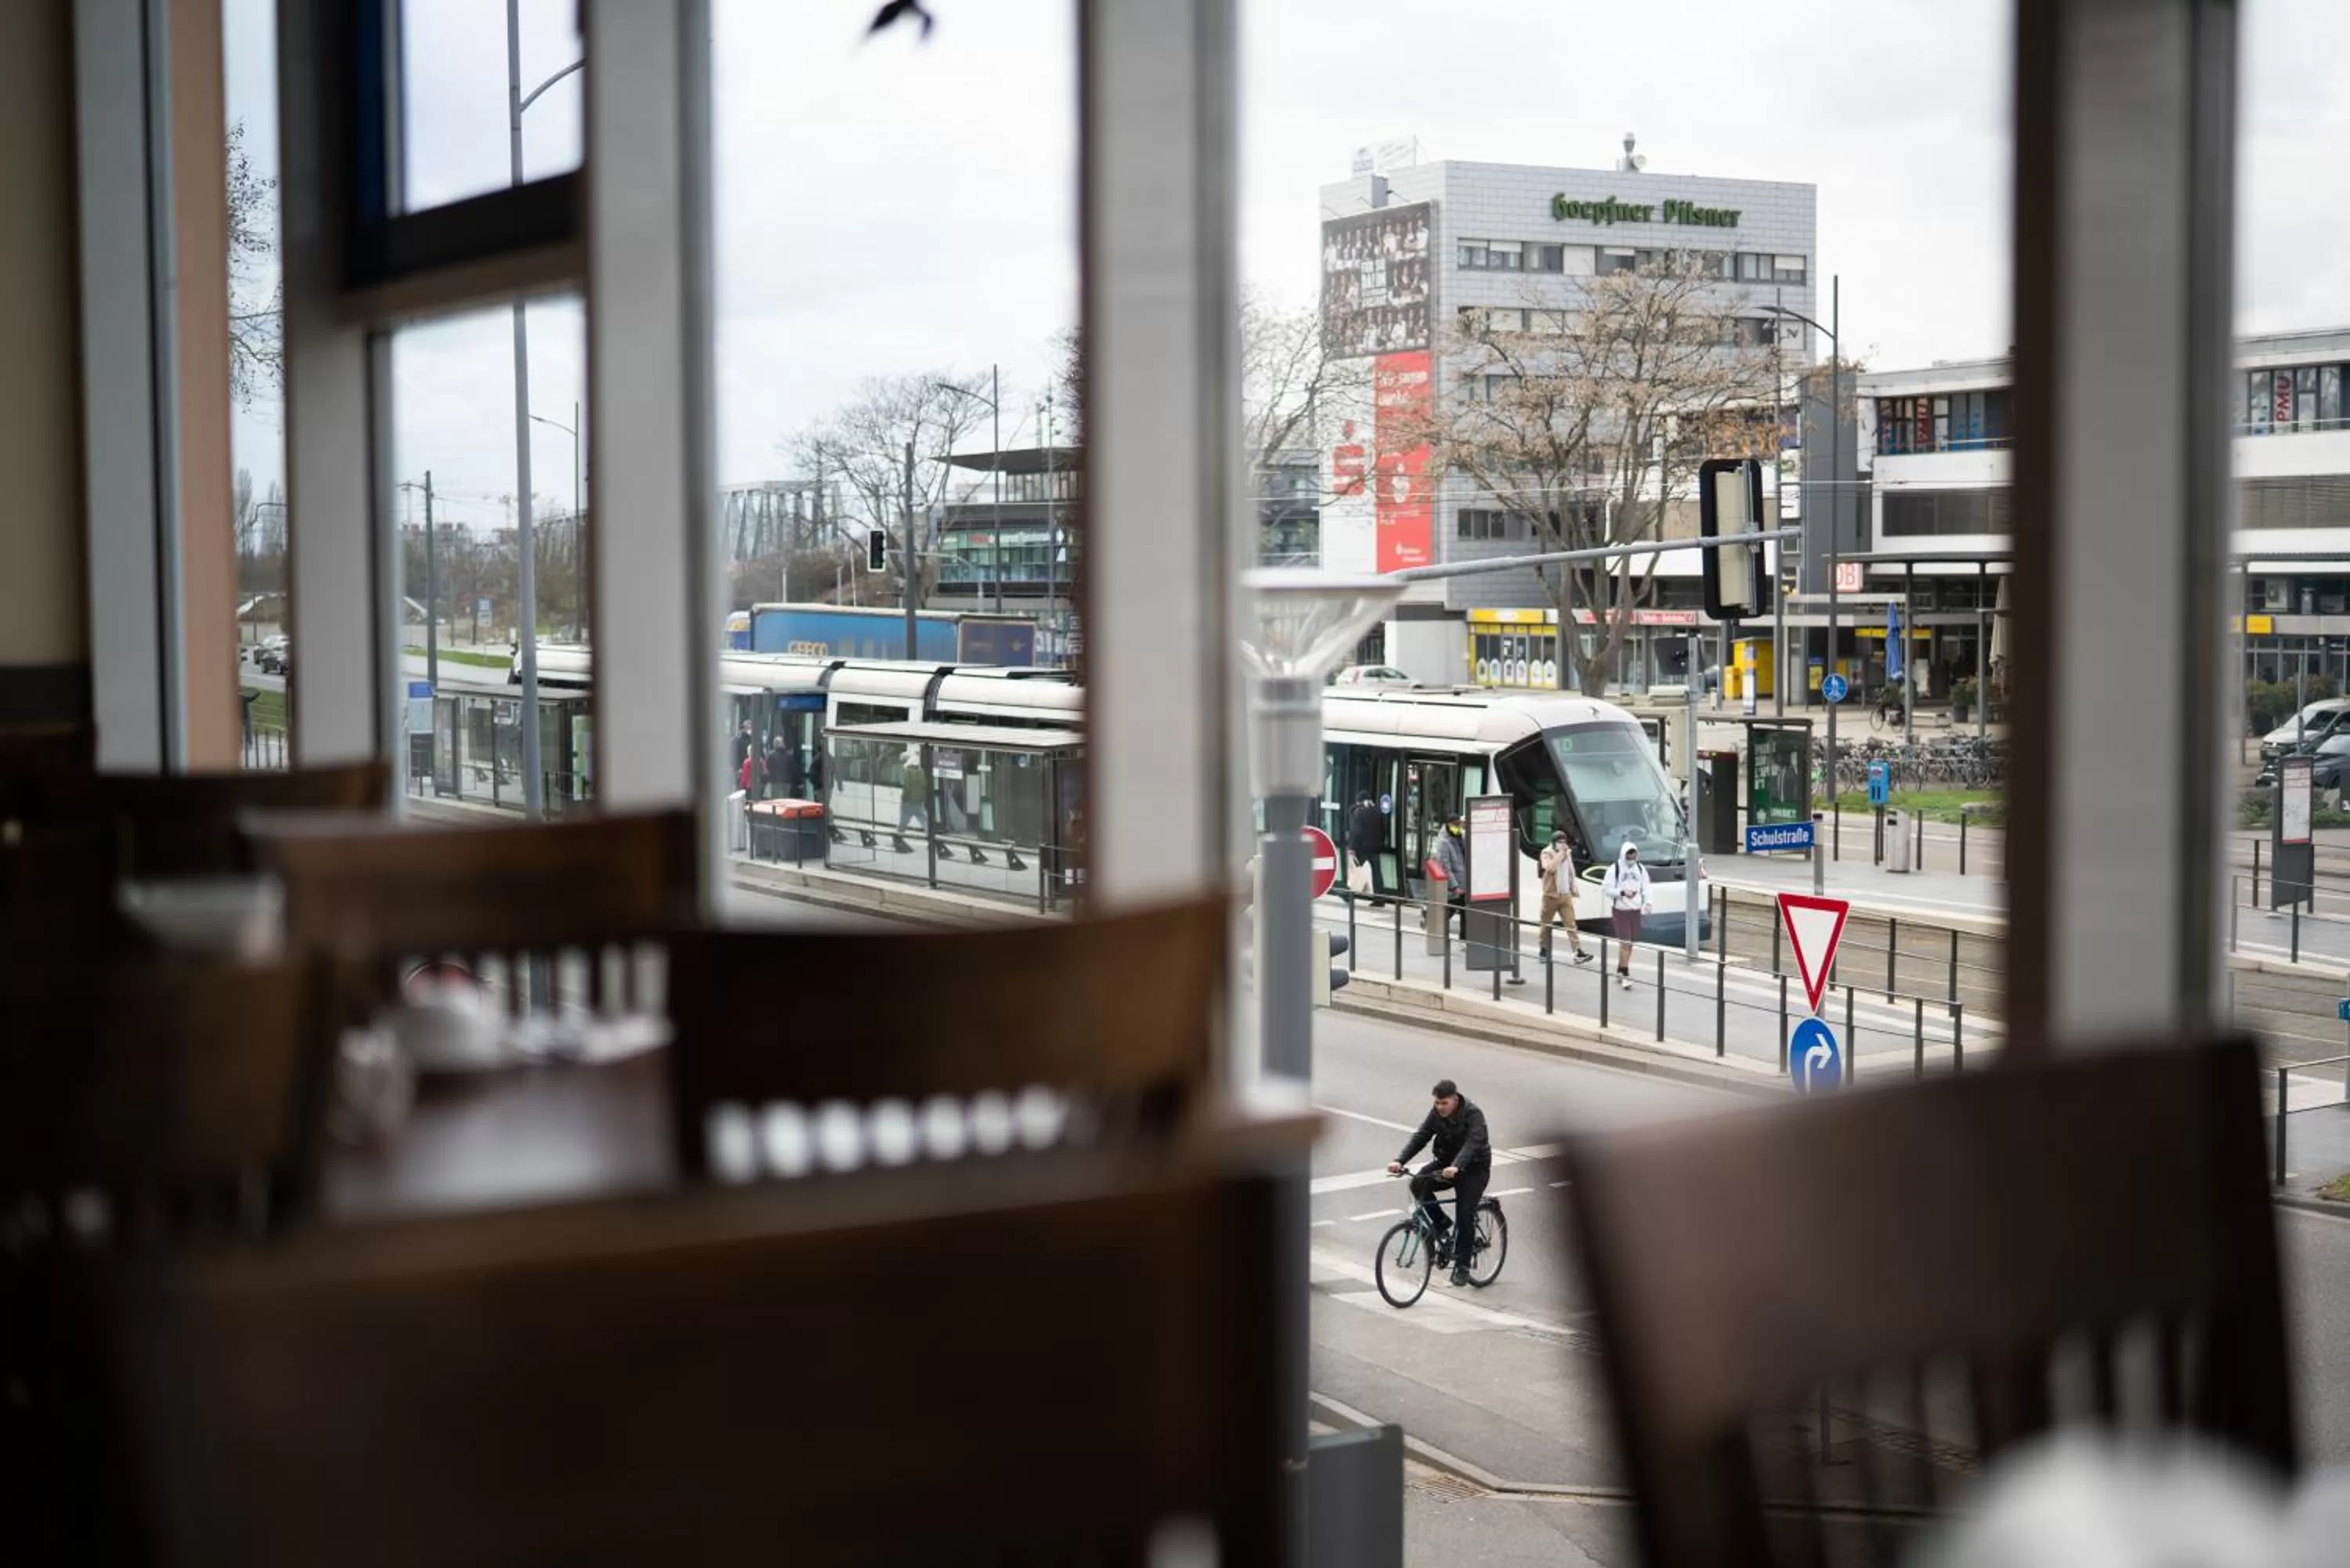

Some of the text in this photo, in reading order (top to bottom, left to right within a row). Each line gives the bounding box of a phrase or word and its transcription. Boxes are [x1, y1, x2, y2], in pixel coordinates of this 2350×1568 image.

[1663, 198, 1743, 227] Pilsner
[2276, 376, 2291, 422] PMU
[1751, 827, 1810, 847] Schulstraße
